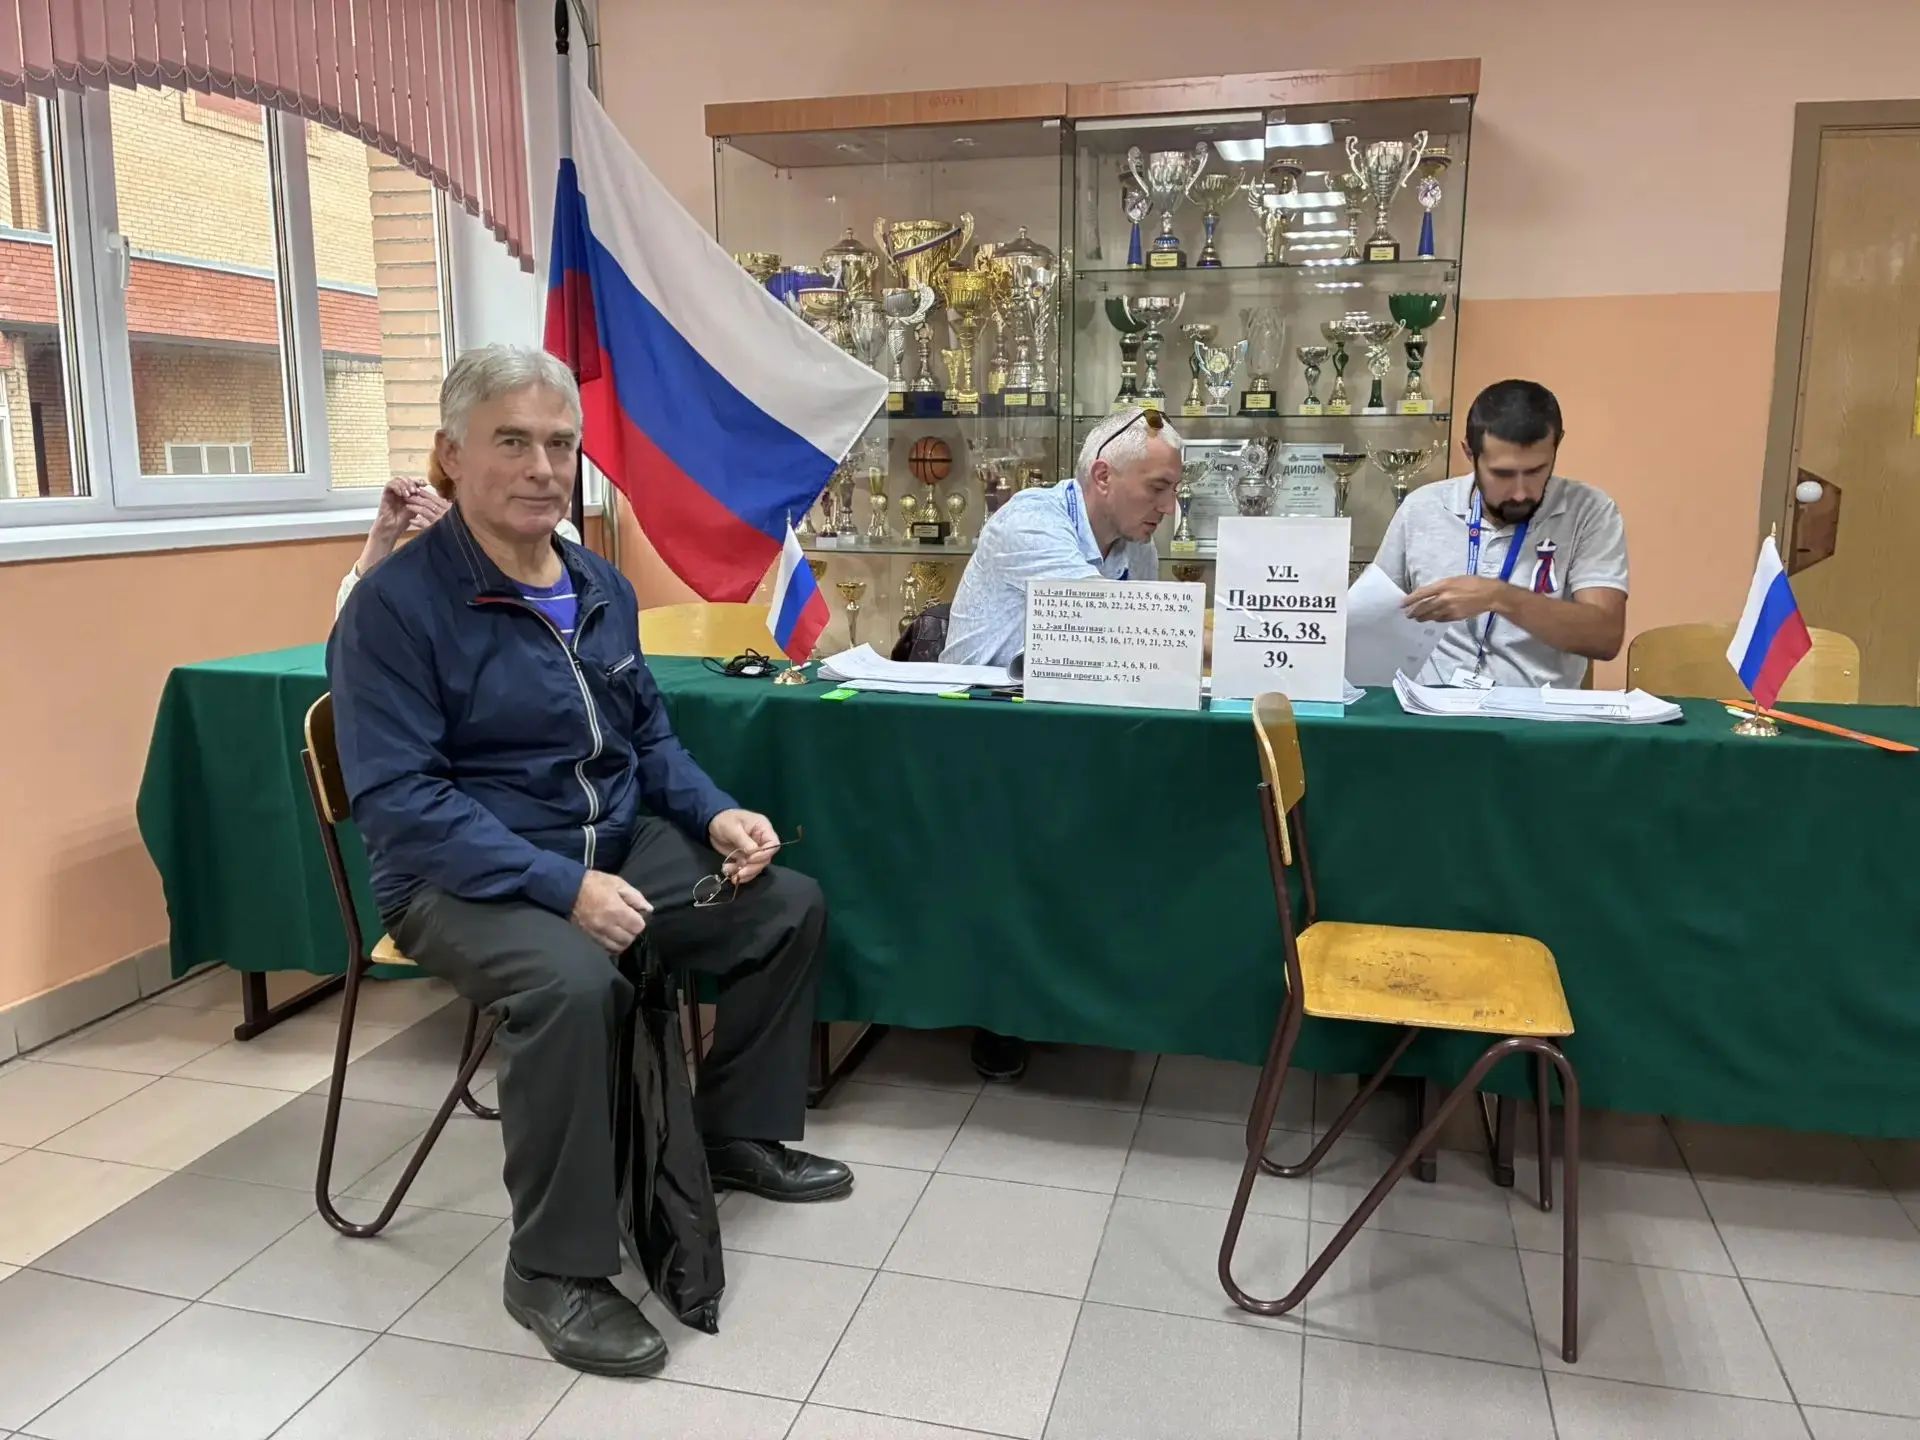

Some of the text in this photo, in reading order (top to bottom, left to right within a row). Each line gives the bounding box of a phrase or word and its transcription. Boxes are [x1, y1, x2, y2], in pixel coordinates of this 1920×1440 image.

[1283, 464, 1326, 476] ДИПЛОМ
[1266, 565, 1299, 582] ул.
[1119, 591, 1126, 600] 1,
[1127, 591, 1135, 600] 2,
[1136, 592, 1144, 601] 3,
[1145, 592, 1153, 601] 5,
[1154, 593, 1162, 601] 6,
[1163, 593, 1171, 601] 8,
[1172, 593, 1180, 602] 9,
[1182, 594, 1193, 603] 10,
[1227, 589, 1337, 612] Парковая
[1033, 598, 1190, 613] 11, 12, 14, 16, 18, 20, 22, 24, 25, 27, 28, 29,
[1033, 609, 1082, 619] 30, 31, 32, 34.
[1117, 626, 1124, 634] 1,
[1125, 626, 1133, 634] 2,
[1134, 627, 1142, 635] 3,
[1143, 627, 1151, 635] 4,
[1152, 628, 1160, 636] 5,
[1161, 628, 1168, 636] 6,
[1170, 628, 1177, 637] 7,
[1179, 629, 1187, 637] 8,
[1188, 629, 1196, 638] 9,
[1233, 621, 1326, 644] д. 36, 38,
[1033, 632, 1188, 648] 10, 11, 12, 13, 14, 15, 16, 17, 19, 21, 23, 25,
[1121, 661, 1129, 669] 4,
[1130, 661, 1138, 669] 6,
[1139, 662, 1147, 670] 8,
[1263, 650, 1294, 669] 39.
[1031, 669, 1072, 680] Архивный
[1113, 674, 1121, 682] 5,
[1122, 674, 1129, 683] 7,
[1131, 675, 1141, 683] 15
